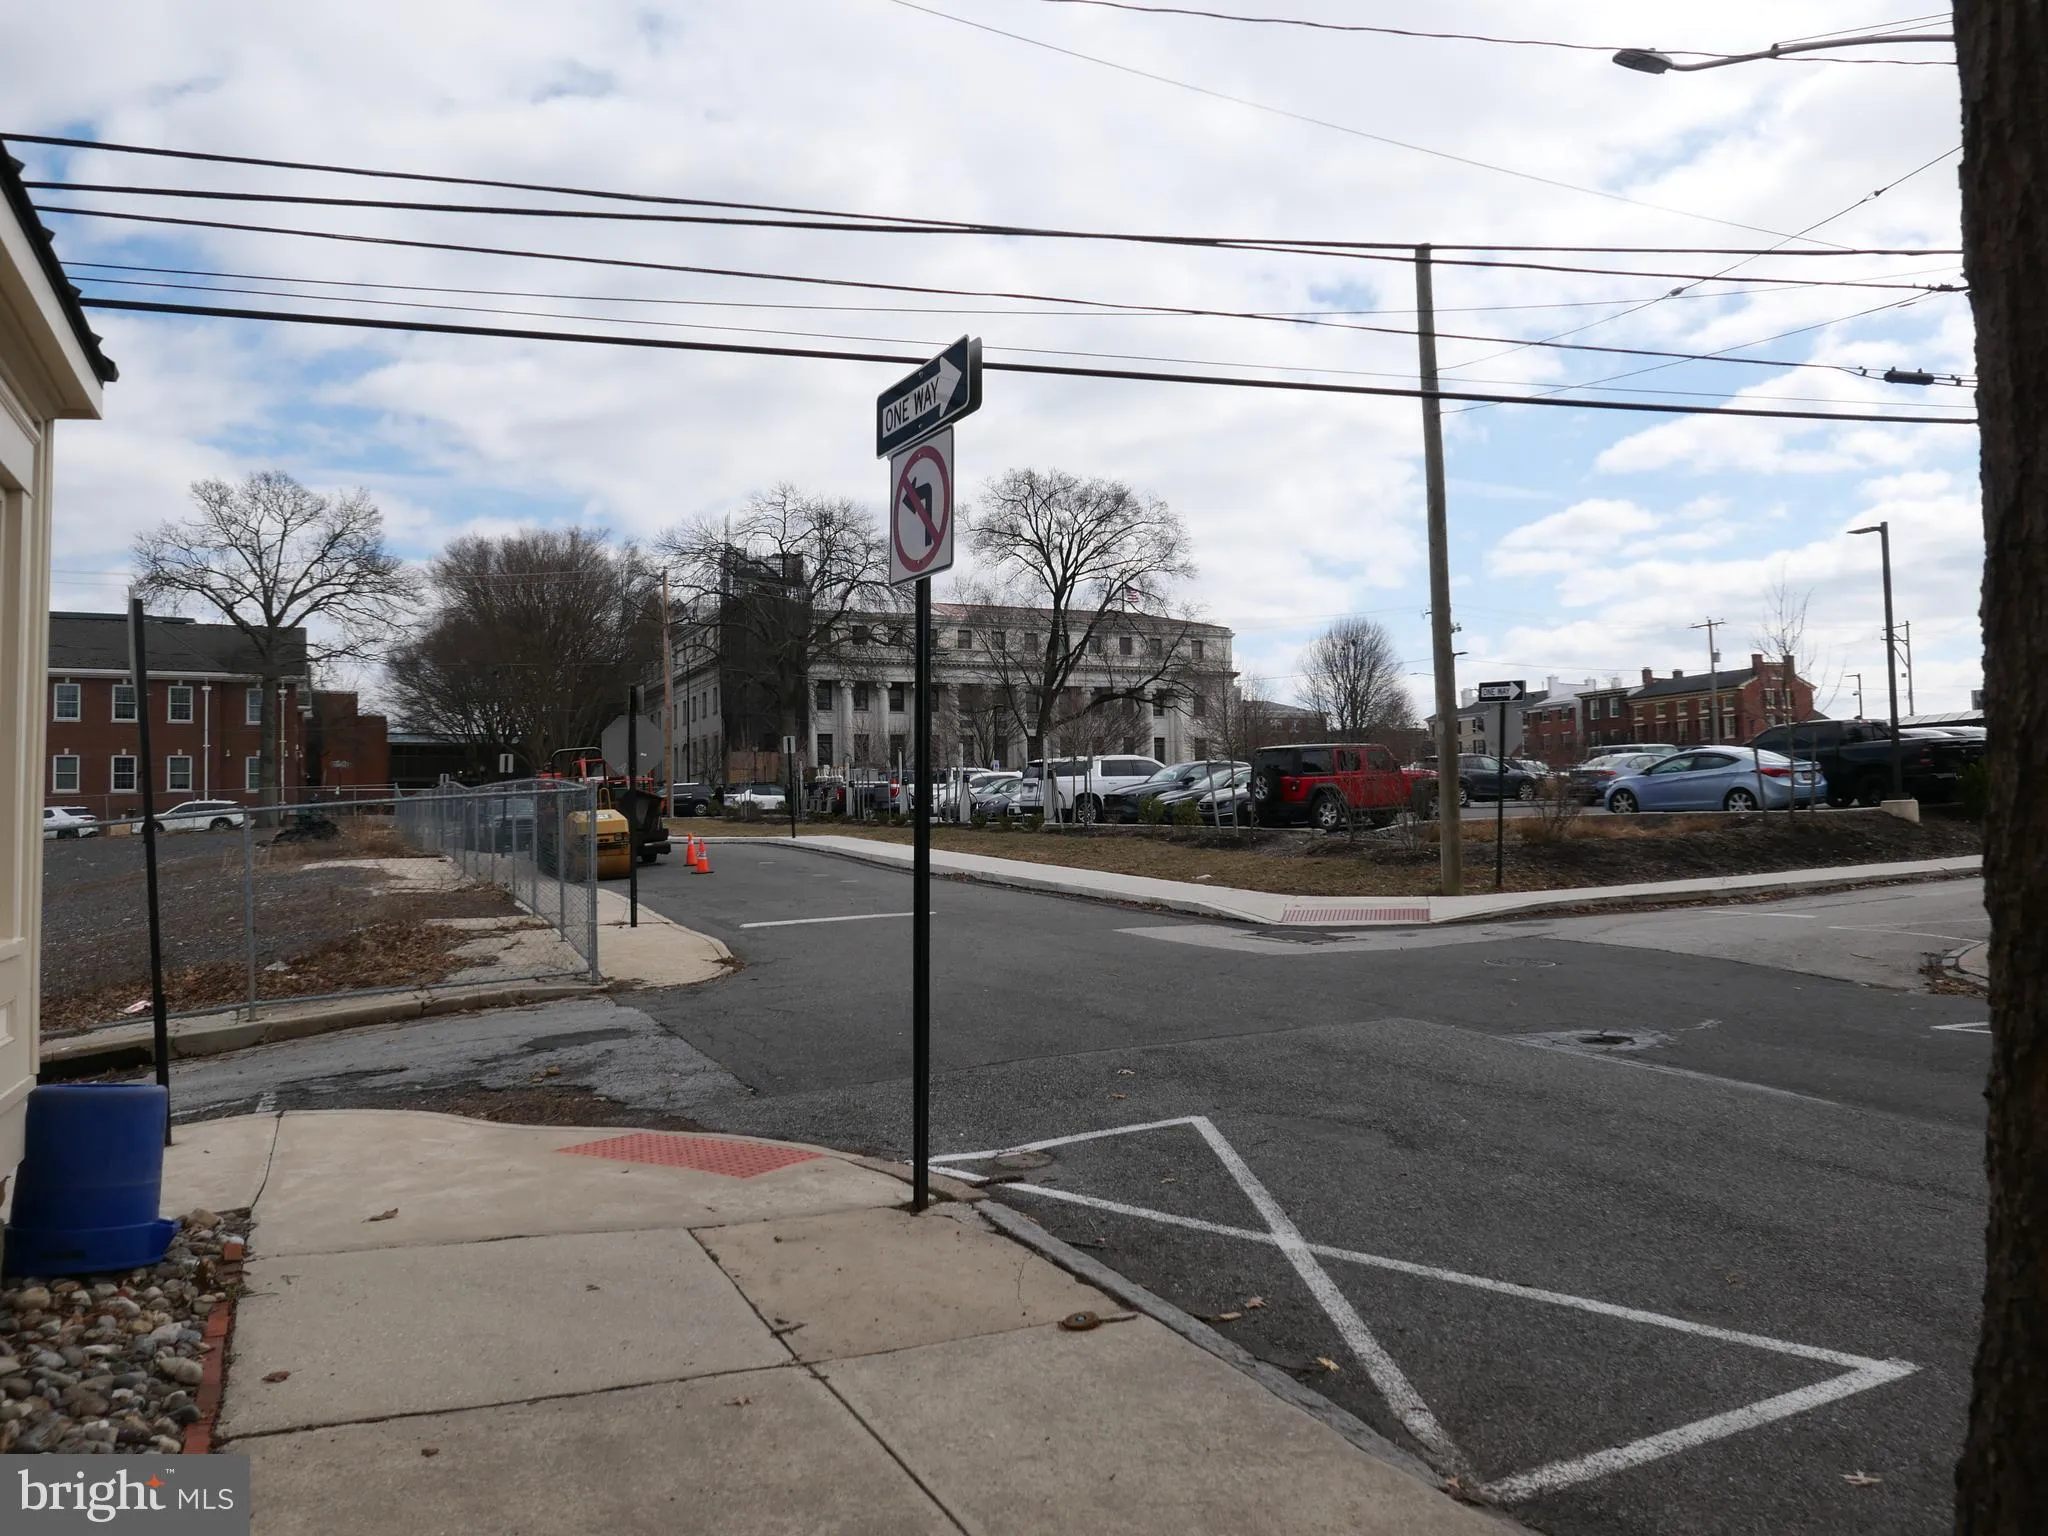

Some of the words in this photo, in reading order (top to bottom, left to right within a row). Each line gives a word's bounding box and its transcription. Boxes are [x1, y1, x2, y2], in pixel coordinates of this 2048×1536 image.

[886, 397, 909, 432] ONE
[914, 377, 939, 415] WAY
[1483, 688, 1496, 696] ONE
[1497, 687, 1510, 695] WAY
